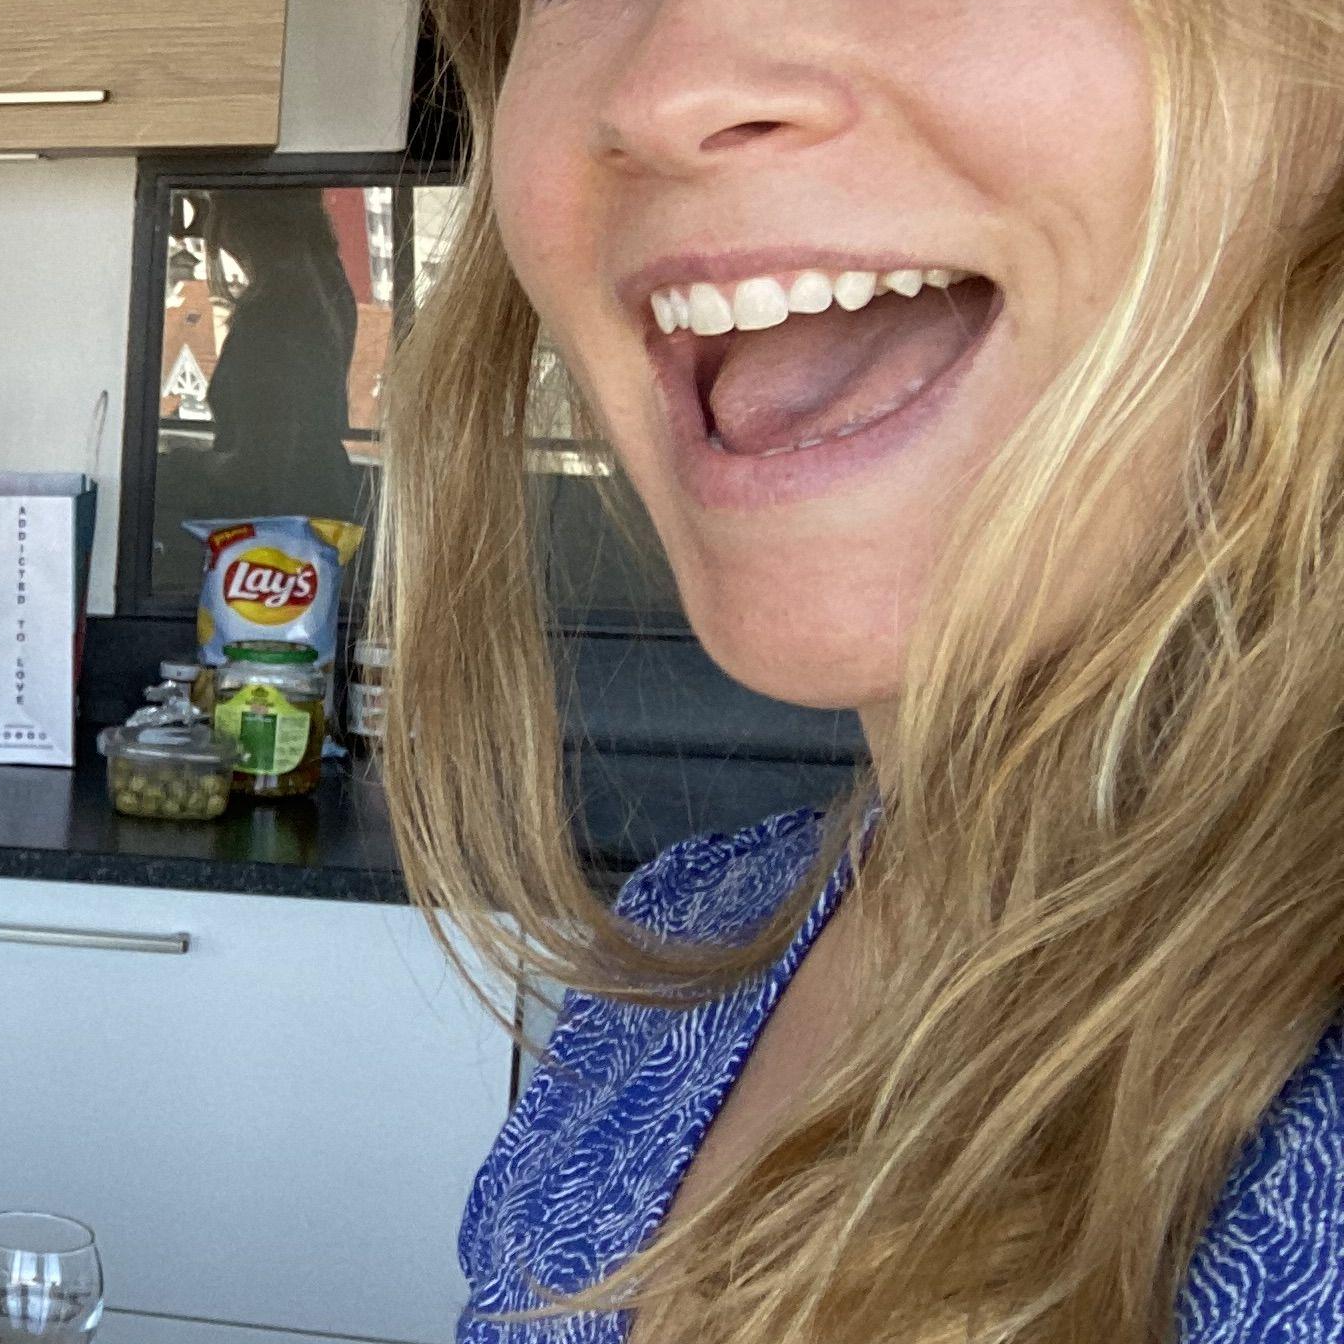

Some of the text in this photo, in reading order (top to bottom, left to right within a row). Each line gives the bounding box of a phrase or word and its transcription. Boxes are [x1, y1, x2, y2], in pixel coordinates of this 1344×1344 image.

[15, 506, 27, 705] ADDICTED TO LOVE
[228, 561, 313, 608] Lay's
